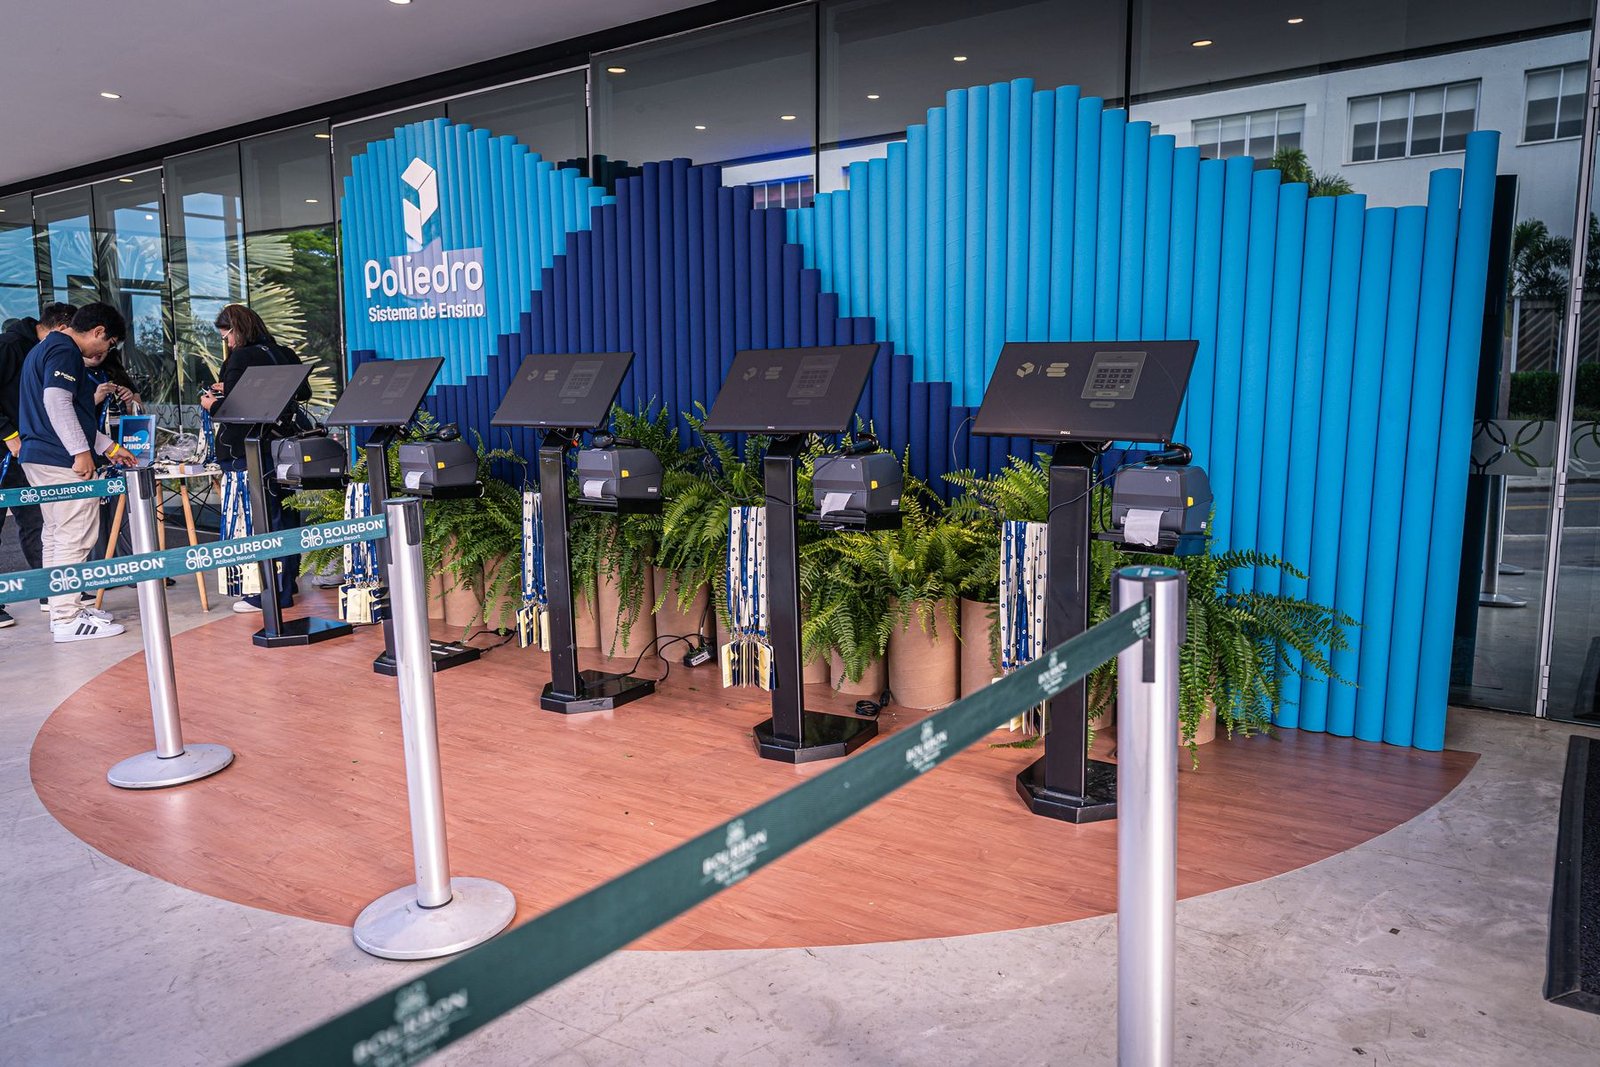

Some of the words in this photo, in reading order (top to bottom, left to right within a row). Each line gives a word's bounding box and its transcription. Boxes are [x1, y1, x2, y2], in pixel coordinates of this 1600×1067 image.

[364, 251, 483, 299] Poliedro
[369, 304, 417, 322] Sistema
[420, 302, 436, 320] de
[439, 299, 484, 318] Ensino
[40, 485, 93, 497] BOURBON
[324, 520, 384, 538] BOURBON
[213, 537, 282, 559] BOURBON
[236, 553, 256, 561] Resort
[82, 558, 164, 580] BOURBON
[110, 575, 133, 583] Resort
